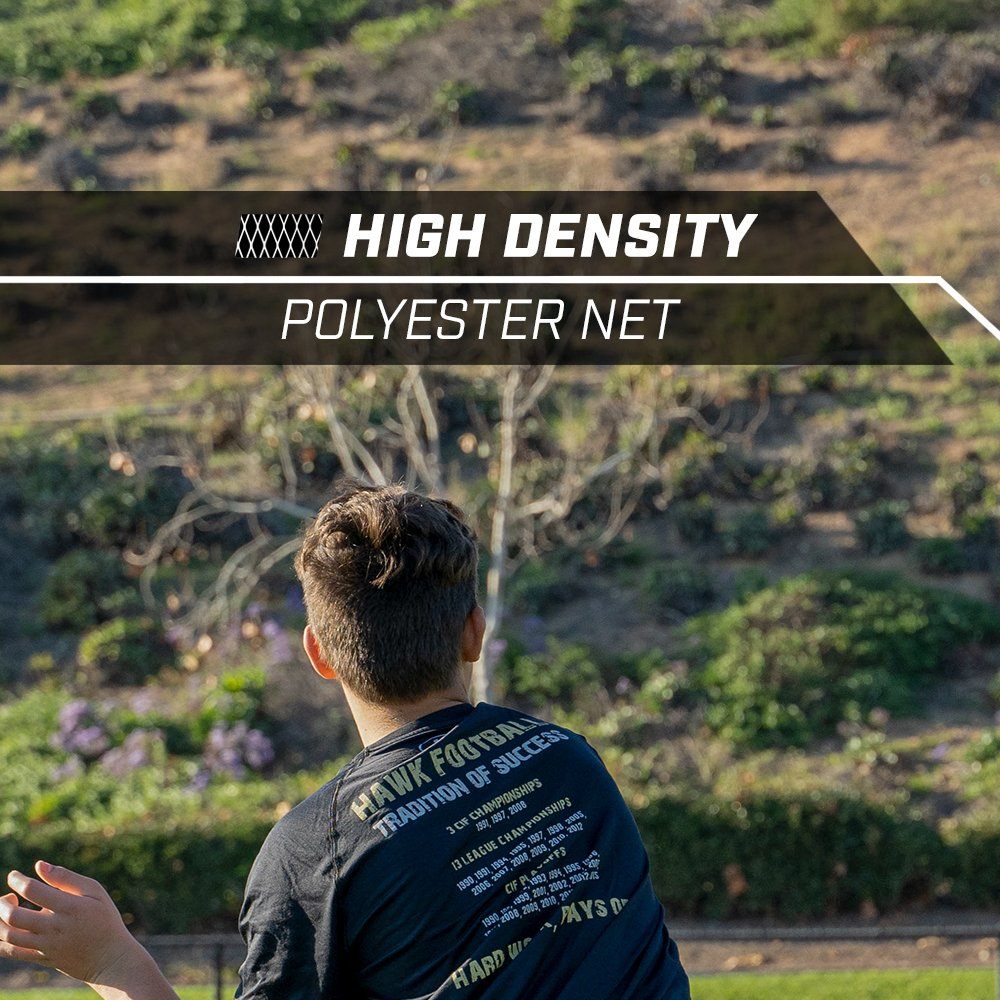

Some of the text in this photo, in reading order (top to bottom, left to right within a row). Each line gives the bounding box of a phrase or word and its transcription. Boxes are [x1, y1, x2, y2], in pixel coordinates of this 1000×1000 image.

[351, 757, 432, 821] HAWK
[372, 729, 570, 838] TRADITION OF SUCCESS
[446, 778, 543, 835] 3 CIF CHAMPIONSHIPS
[475, 800, 528, 831] 1991, 1997, 2008
[451, 797, 572, 871] 13 LEAGUE CHAMPIONSHIPS
[456, 876, 478, 891] 1990,
[474, 866, 494, 880] 1991,
[527, 831, 547, 844] 1997,
[565, 810, 587, 825] 2005,
[471, 880, 494, 896] 2006,
[491, 865, 513, 881] 2007,
[567, 822, 584, 833] 2012
[504, 880, 518, 894] CIF
[549, 879, 571, 892] 2002,
[451, 949, 506, 989] HARD
[560, 899, 608, 926] PAYS
